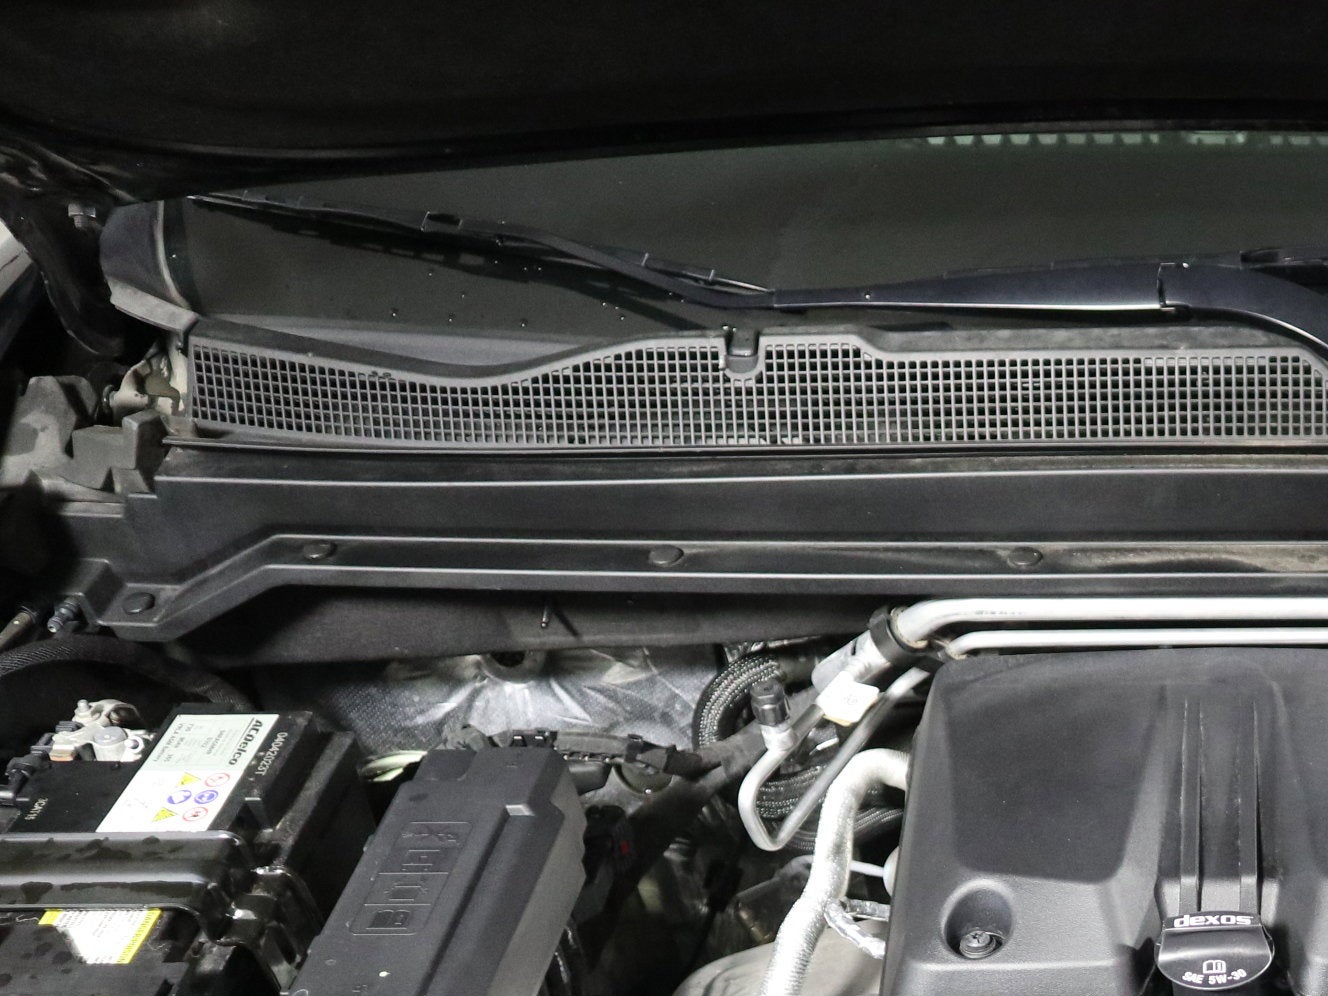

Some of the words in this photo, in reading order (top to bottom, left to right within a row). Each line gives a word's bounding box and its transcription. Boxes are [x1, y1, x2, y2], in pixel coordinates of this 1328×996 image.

[1174, 915, 1254, 928] dexos
[1182, 971, 1204, 984] SAE
[1208, 969, 1247, 985] 5W-30
